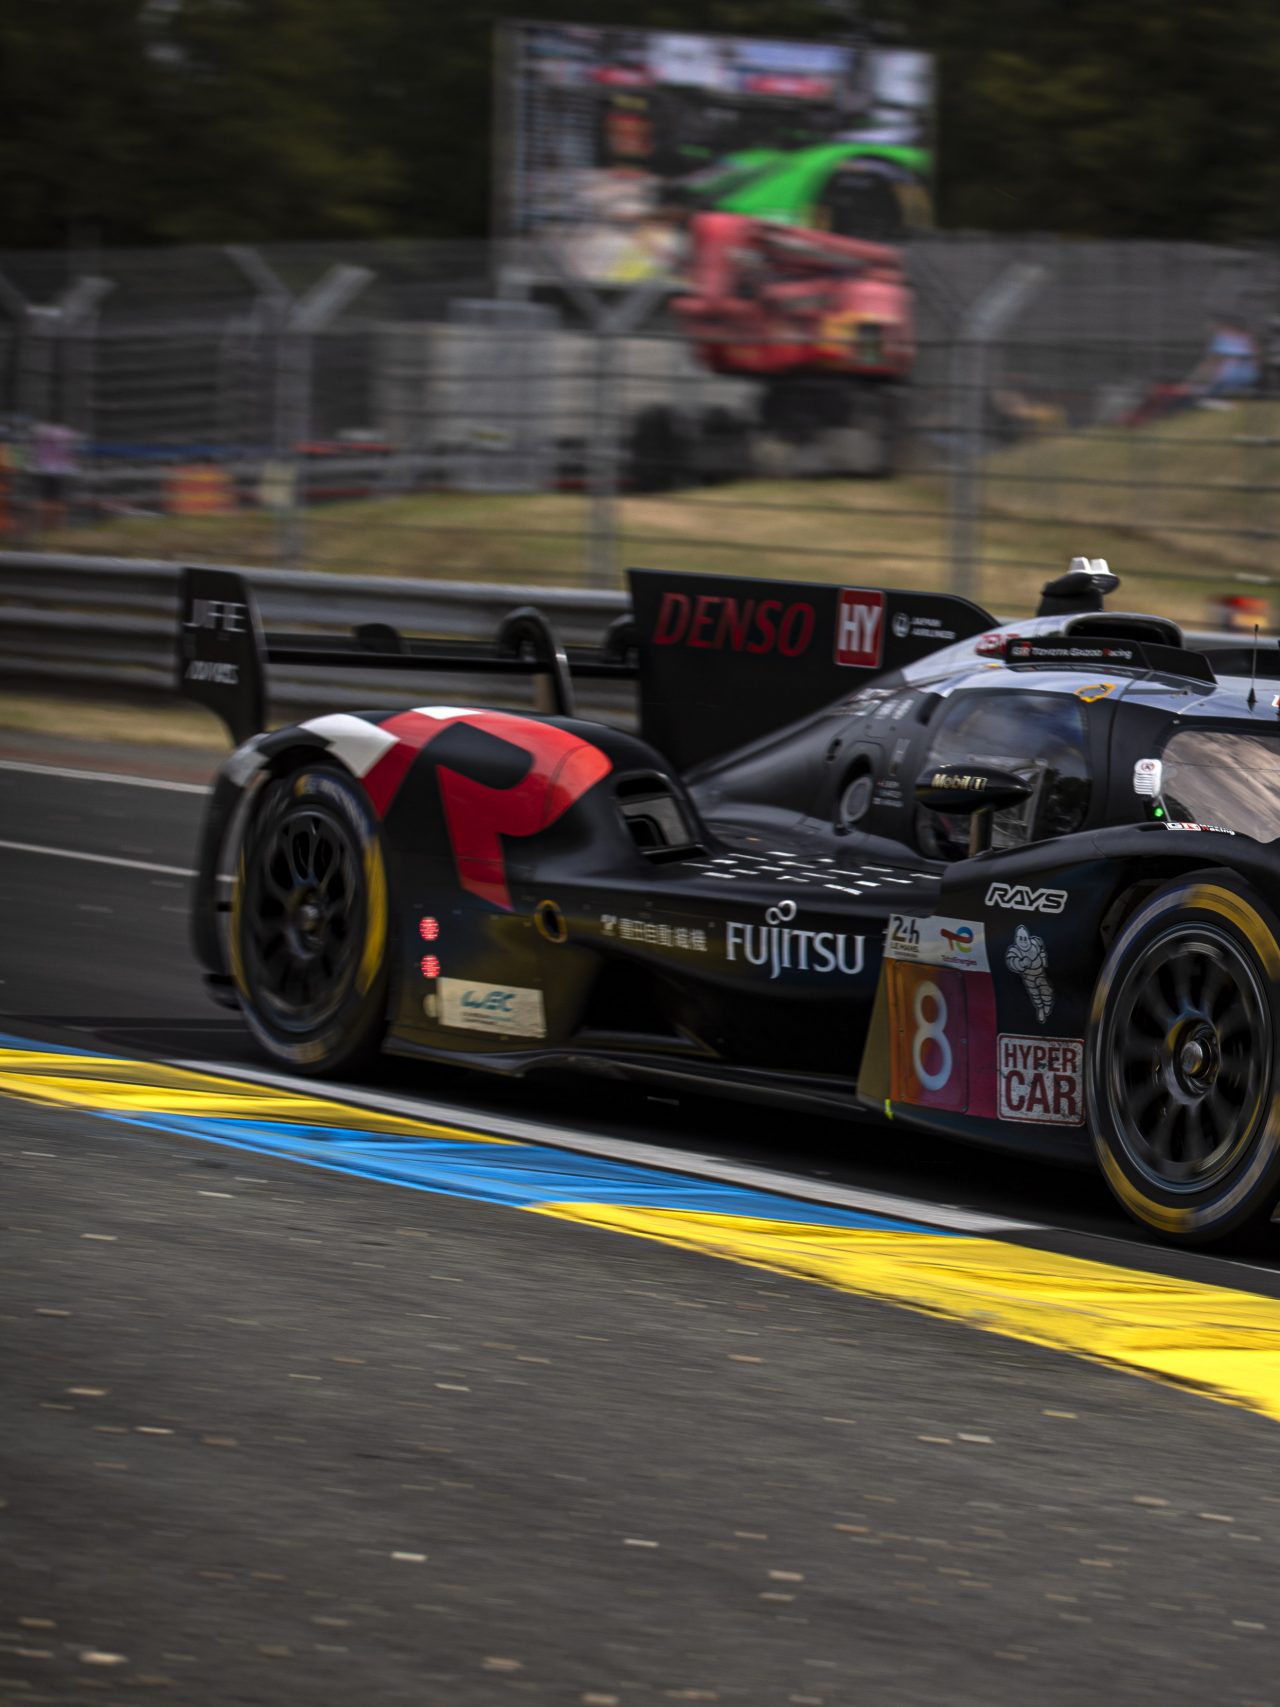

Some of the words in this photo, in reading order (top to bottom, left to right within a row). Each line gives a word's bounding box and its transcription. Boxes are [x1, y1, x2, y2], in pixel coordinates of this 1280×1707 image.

[653, 592, 815, 657] DENSO
[837, 603, 882, 653] HY
[985, 882, 1068, 914] RAYS
[725, 919, 866, 979] FUJITSU
[913, 979, 953, 1092] 8
[1004, 1043, 1077, 1073] HYPER
[1005, 1070, 1077, 1116] CAR
